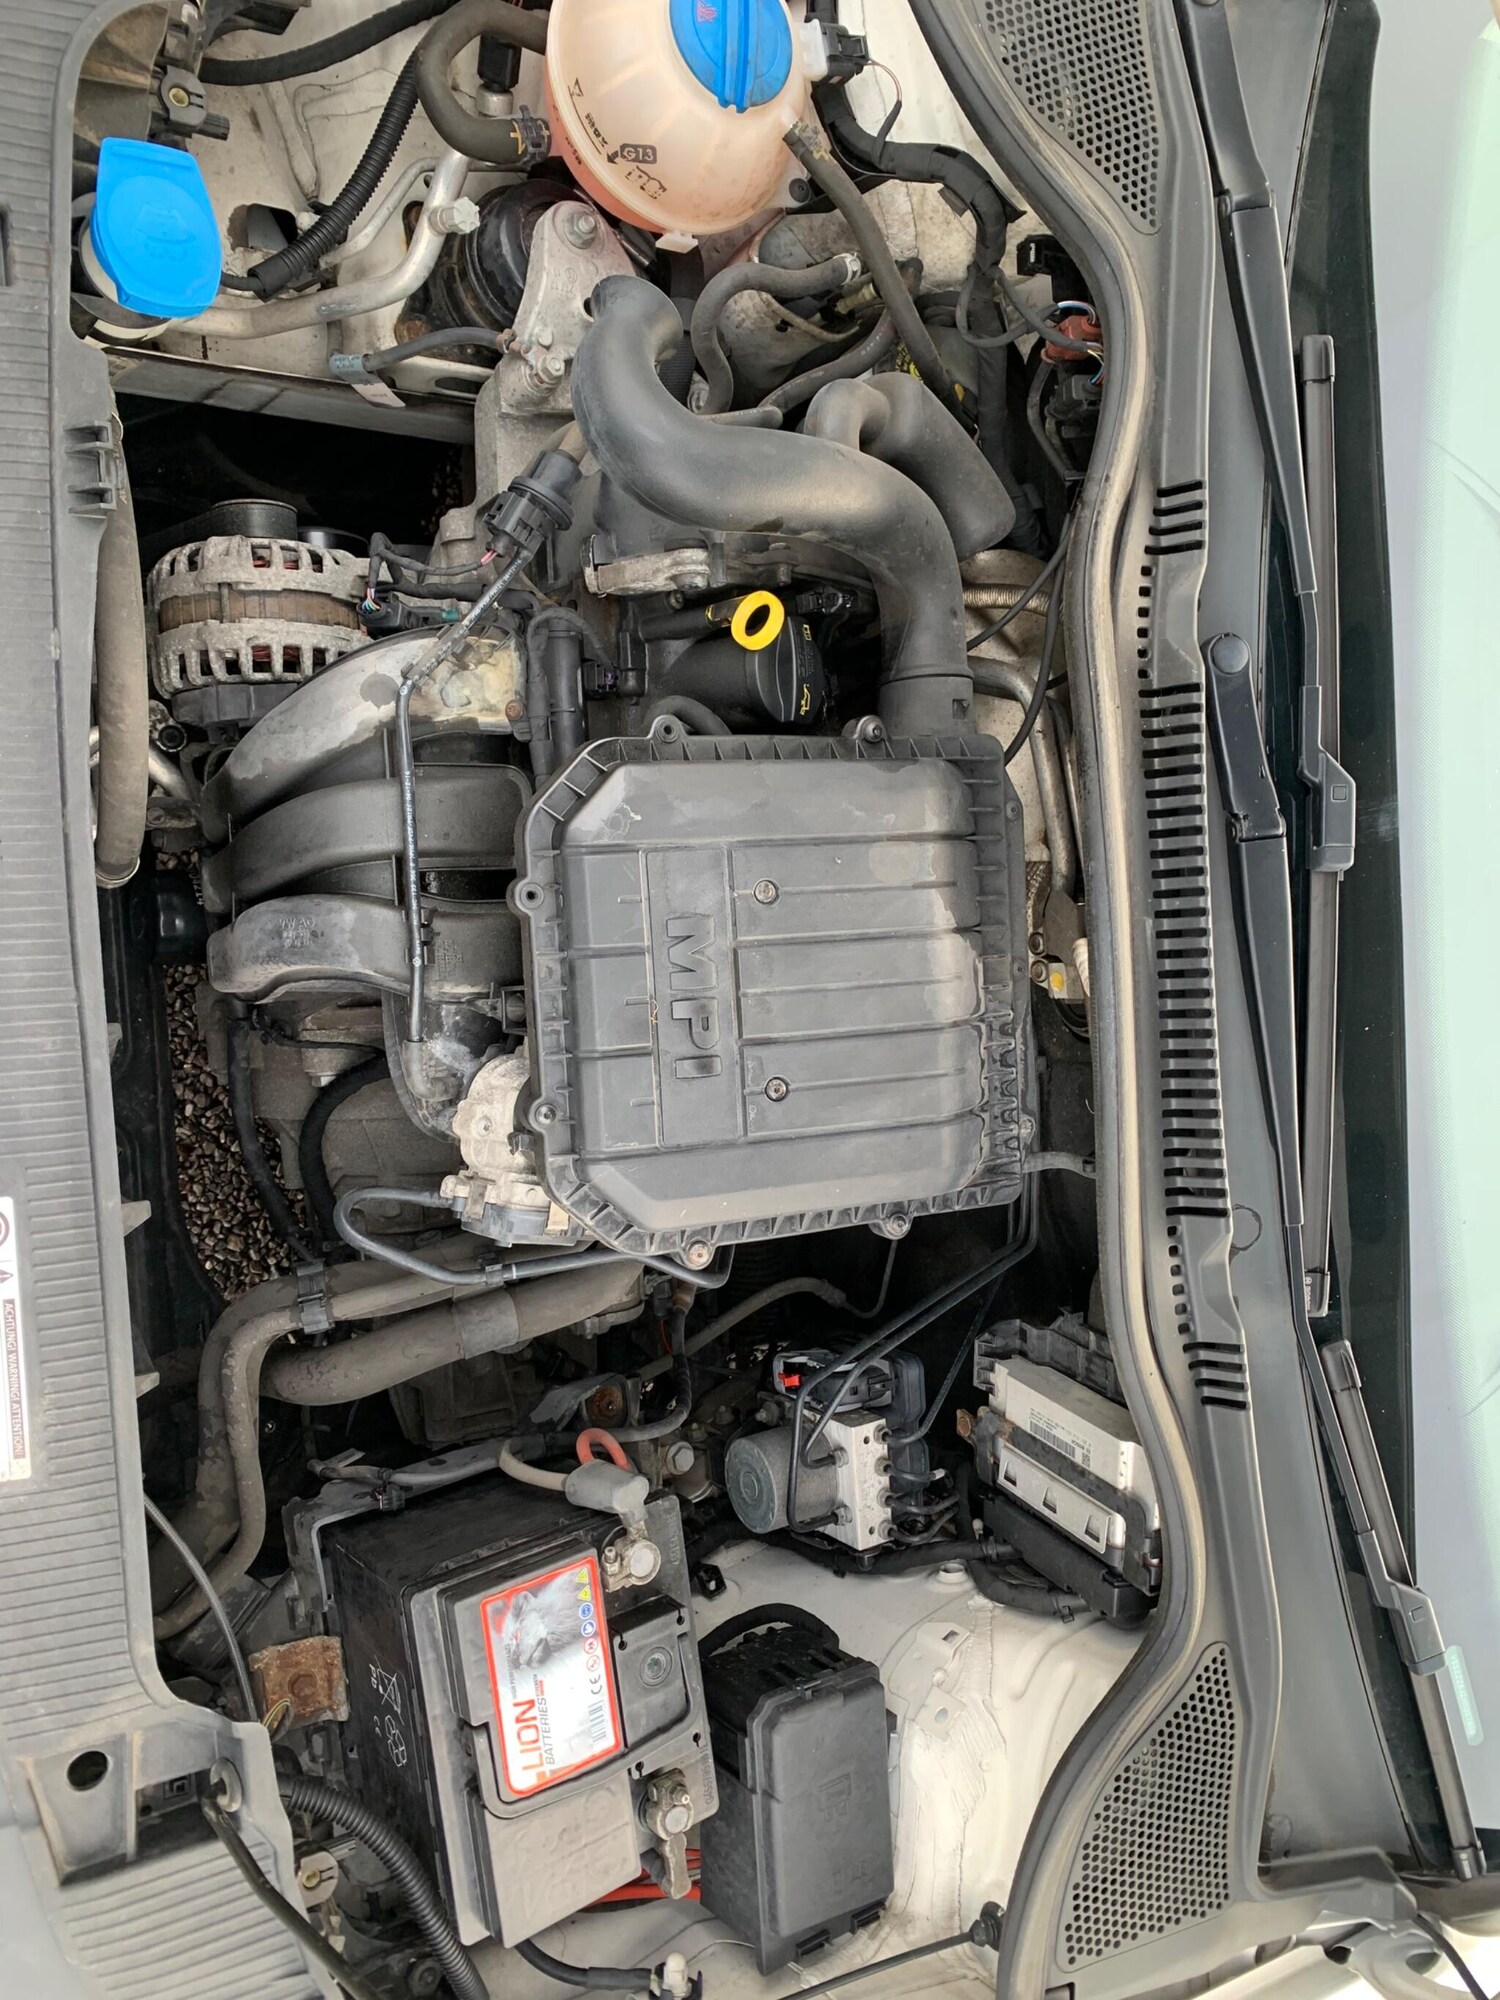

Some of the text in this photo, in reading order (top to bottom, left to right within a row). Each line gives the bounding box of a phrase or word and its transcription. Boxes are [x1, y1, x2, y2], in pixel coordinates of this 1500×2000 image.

[624, 146, 654, 161] G13
[666, 915, 723, 1080] MPI
[4, 1302, 25, 1457] ACHTUNG! WARNING! ATTENTION!
[513, 1699, 544, 1771] LION
[536, 1696, 555, 1766] BATTERIES
